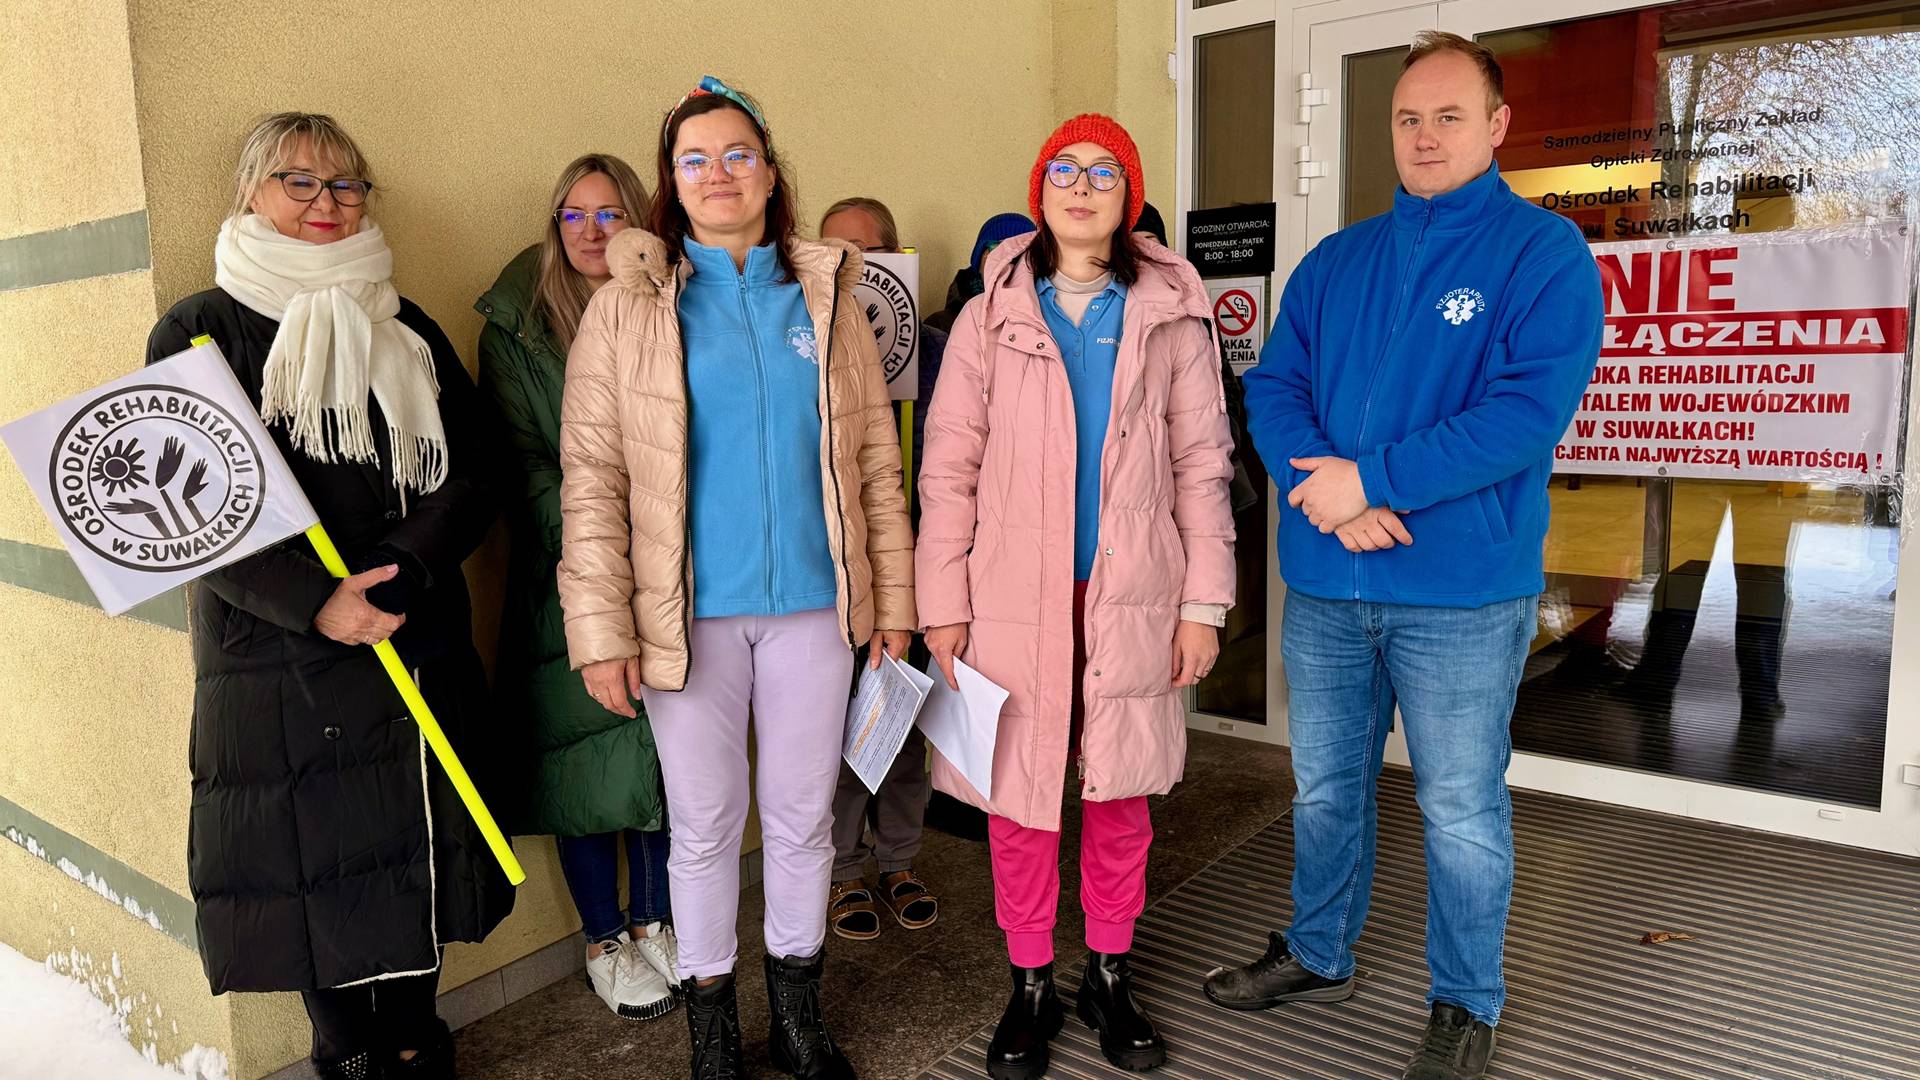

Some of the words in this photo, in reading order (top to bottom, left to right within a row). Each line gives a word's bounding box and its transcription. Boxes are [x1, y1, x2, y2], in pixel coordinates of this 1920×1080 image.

[1543, 127, 1653, 150] Samodzielny
[1659, 117, 1749, 138] Publiczny
[1755, 107, 1822, 127] Zakład
[1590, 151, 1645, 170] Opieki
[1650, 139, 1757, 163] Zdrowotnej
[1542, 185, 1640, 211] Ośrodek
[1650, 168, 1813, 201] Rehabilitacji
[1191, 223, 1226, 234] GODZINY
[1227, 219, 1270, 231] OTWARCIA:
[1614, 208, 1751, 237] Suwałkach
[1204, 251, 1224, 260] 8:00
[1230, 248, 1254, 258] 18:00
[1595, 247, 1738, 315] NIE
[1638, 363, 1815, 384] REHABILITACJI
[1576, 393, 1651, 412] TALEM
[1659, 389, 1850, 413] WOJEWÓDZKIM
[94, 395, 254, 473] REHABILITACJI
[1576, 420, 1597, 438] W
[1603, 420, 1755, 441] SUWAŁKACH!
[1555, 444, 1620, 462] CJENTA
[1626, 445, 1741, 469] NAJWYŻSZĄ
[1747, 449, 1868, 473] WARTOŚCIĄ
[62, 426, 105, 536] OŚRODEK
[137, 484, 254, 562] SUWAŁKACH
